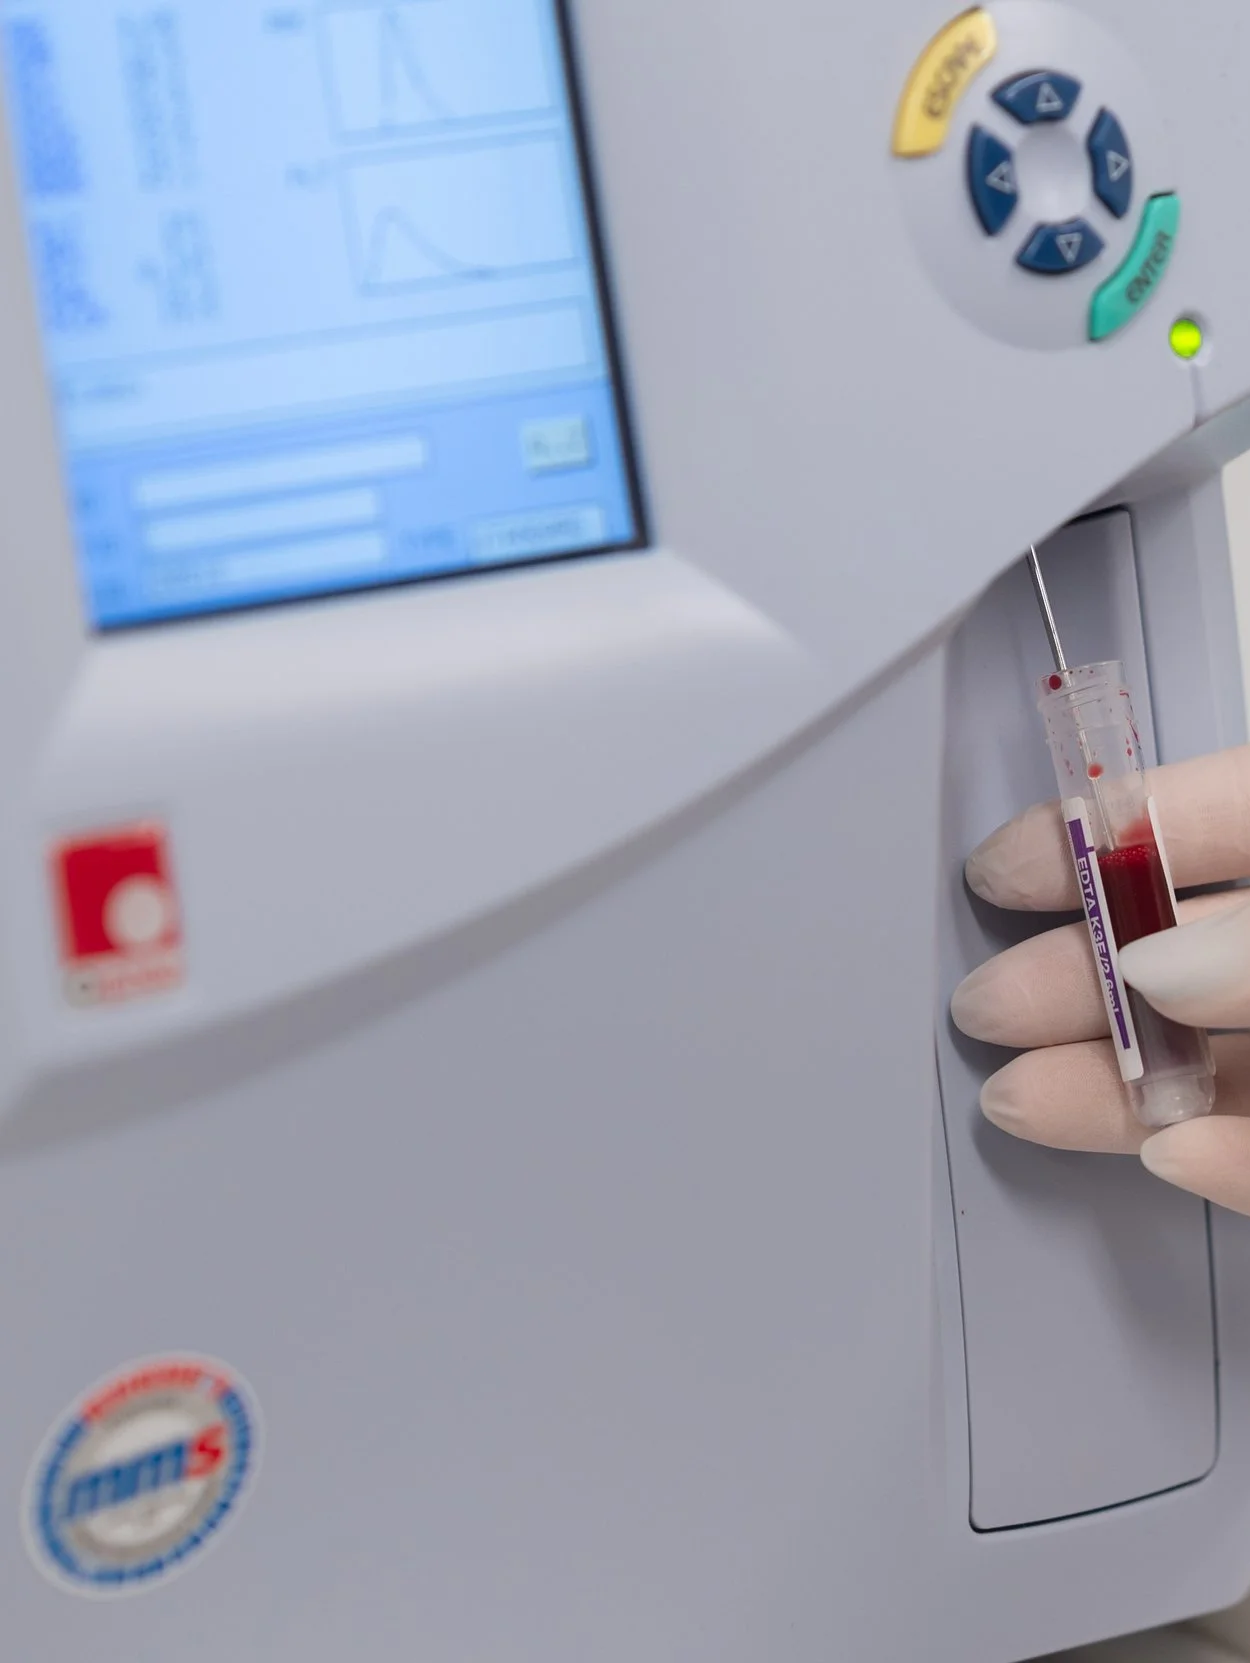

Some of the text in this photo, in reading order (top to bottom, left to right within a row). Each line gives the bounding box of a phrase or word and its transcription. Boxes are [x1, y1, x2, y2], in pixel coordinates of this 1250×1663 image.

[1125, 230, 1171, 304] ENTER
[1077, 856, 1119, 1013] EDTA K3E/26ml
